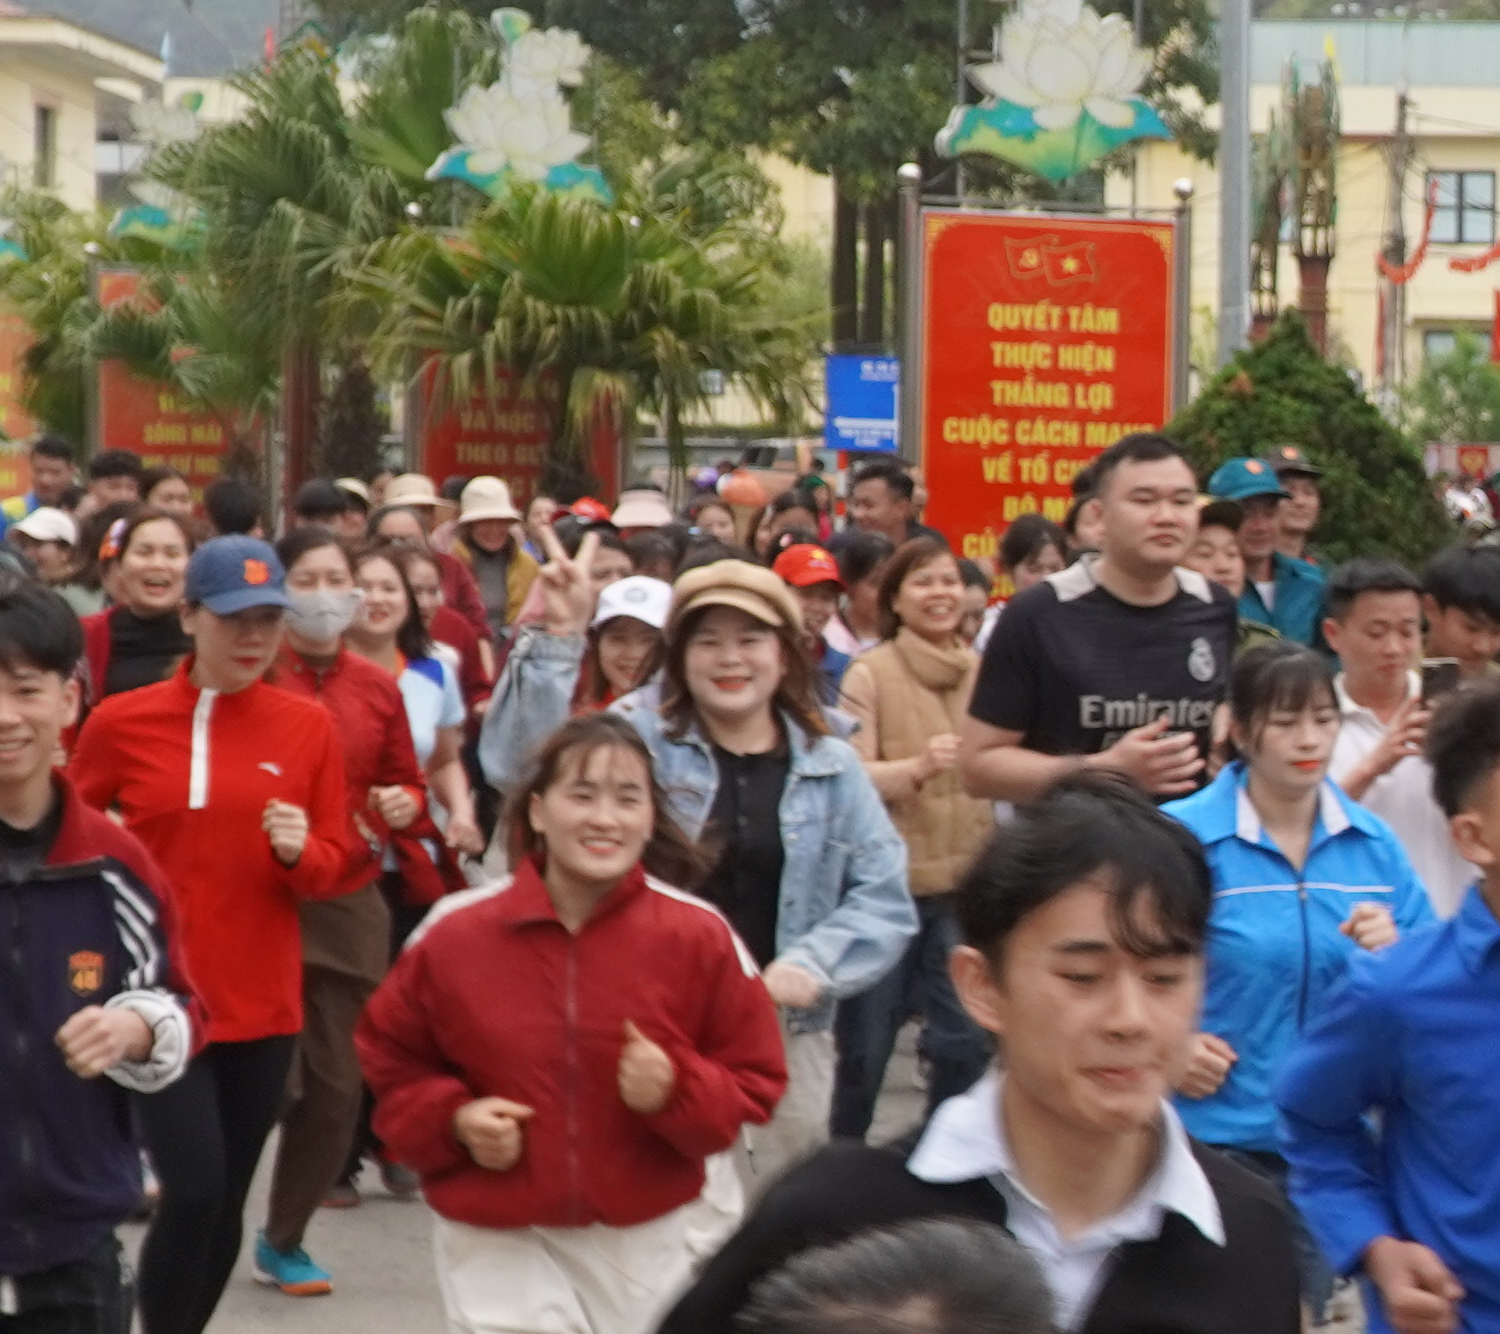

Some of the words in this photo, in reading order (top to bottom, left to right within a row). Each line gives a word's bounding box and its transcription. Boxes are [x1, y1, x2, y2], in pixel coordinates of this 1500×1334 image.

[987, 298, 1061, 332] QUYẾT
[1067, 302, 1120, 334] TÂM
[990, 341, 1052, 373] THỰC
[1058, 341, 1116, 375] HIỆN
[990, 372, 1069, 408] THẮNG
[1075, 383, 1114, 414] LỢI
[943, 414, 1007, 449] CUỘC
[1015, 416, 1080, 447] CÁCH
[982, 455, 1013, 484] VỀ
[1018, 451, 1048, 484] TỔ
[963, 528, 998, 558] CỦ
